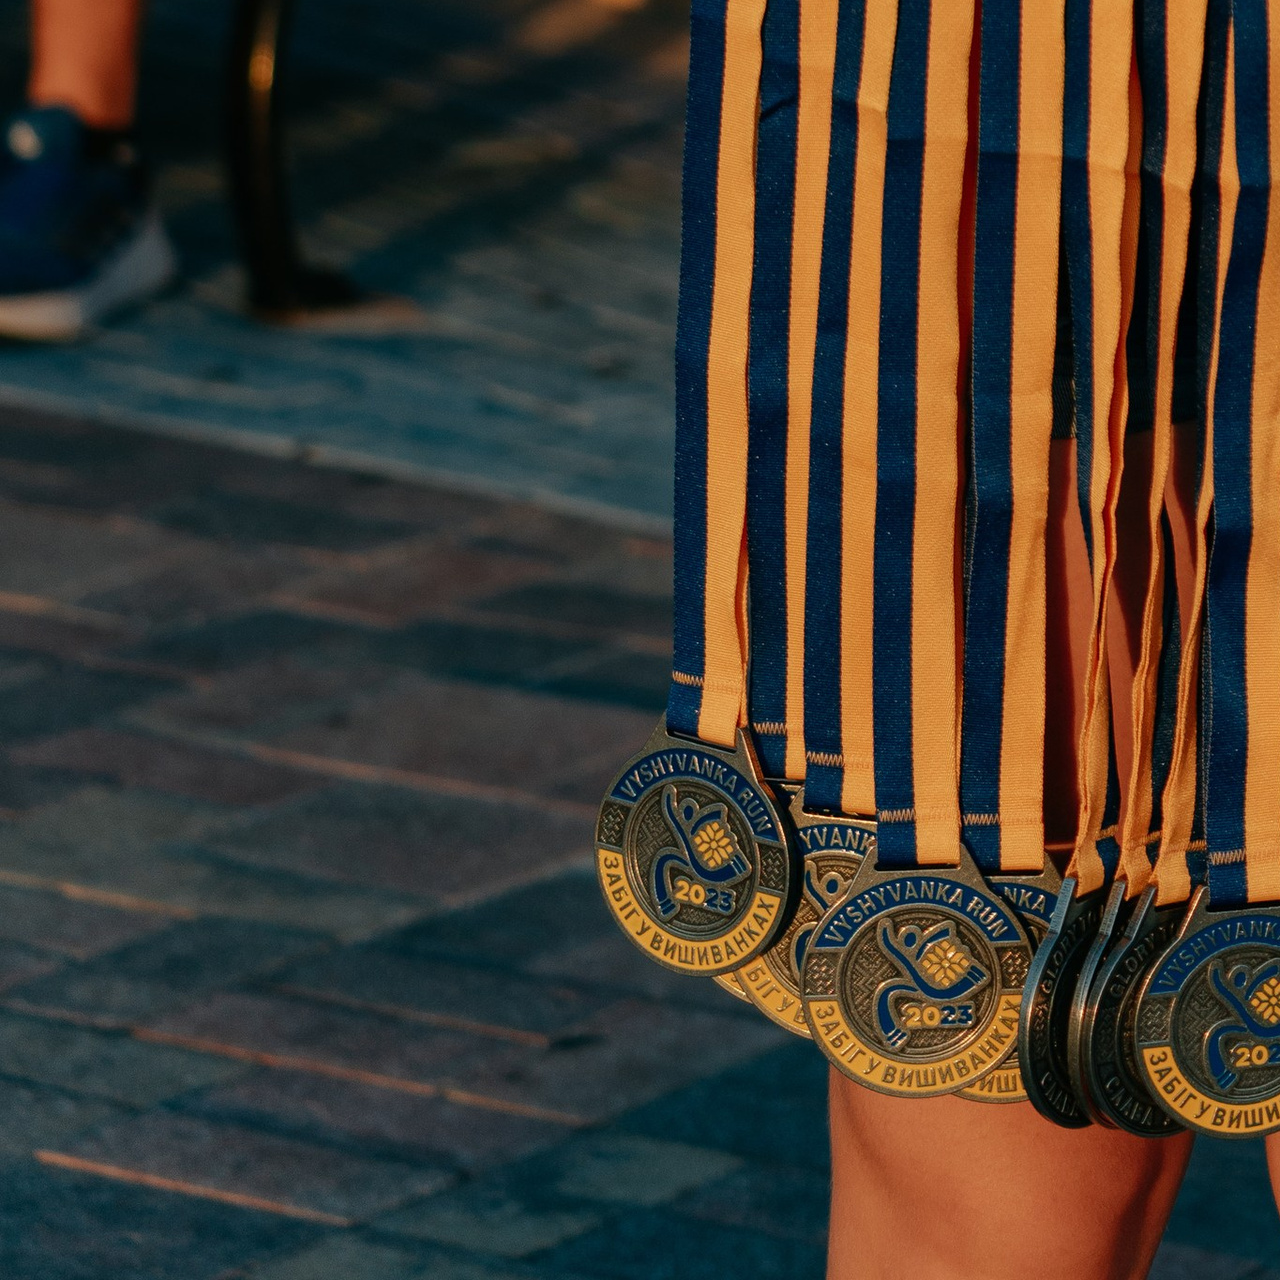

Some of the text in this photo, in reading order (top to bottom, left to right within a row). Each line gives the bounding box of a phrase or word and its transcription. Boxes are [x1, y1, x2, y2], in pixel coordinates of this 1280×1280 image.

[620, 753, 772, 833] VYSHYVANKA RUN
[603, 855, 639, 924] ЗАБІГ
[650, 900, 775, 966] ВИШИВАНКАХ
[674, 878, 735, 912] 2023
[824, 880, 963, 943] VYSHYVANKA
[967, 892, 1009, 940] RUN
[815, 1003, 867, 1063] ЗАБІГ
[880, 998, 1021, 1088] ВИШИВАНКАХ
[905, 1004, 975, 1027] 2023
[1150, 1051, 1198, 1109] ЗАБІГ
